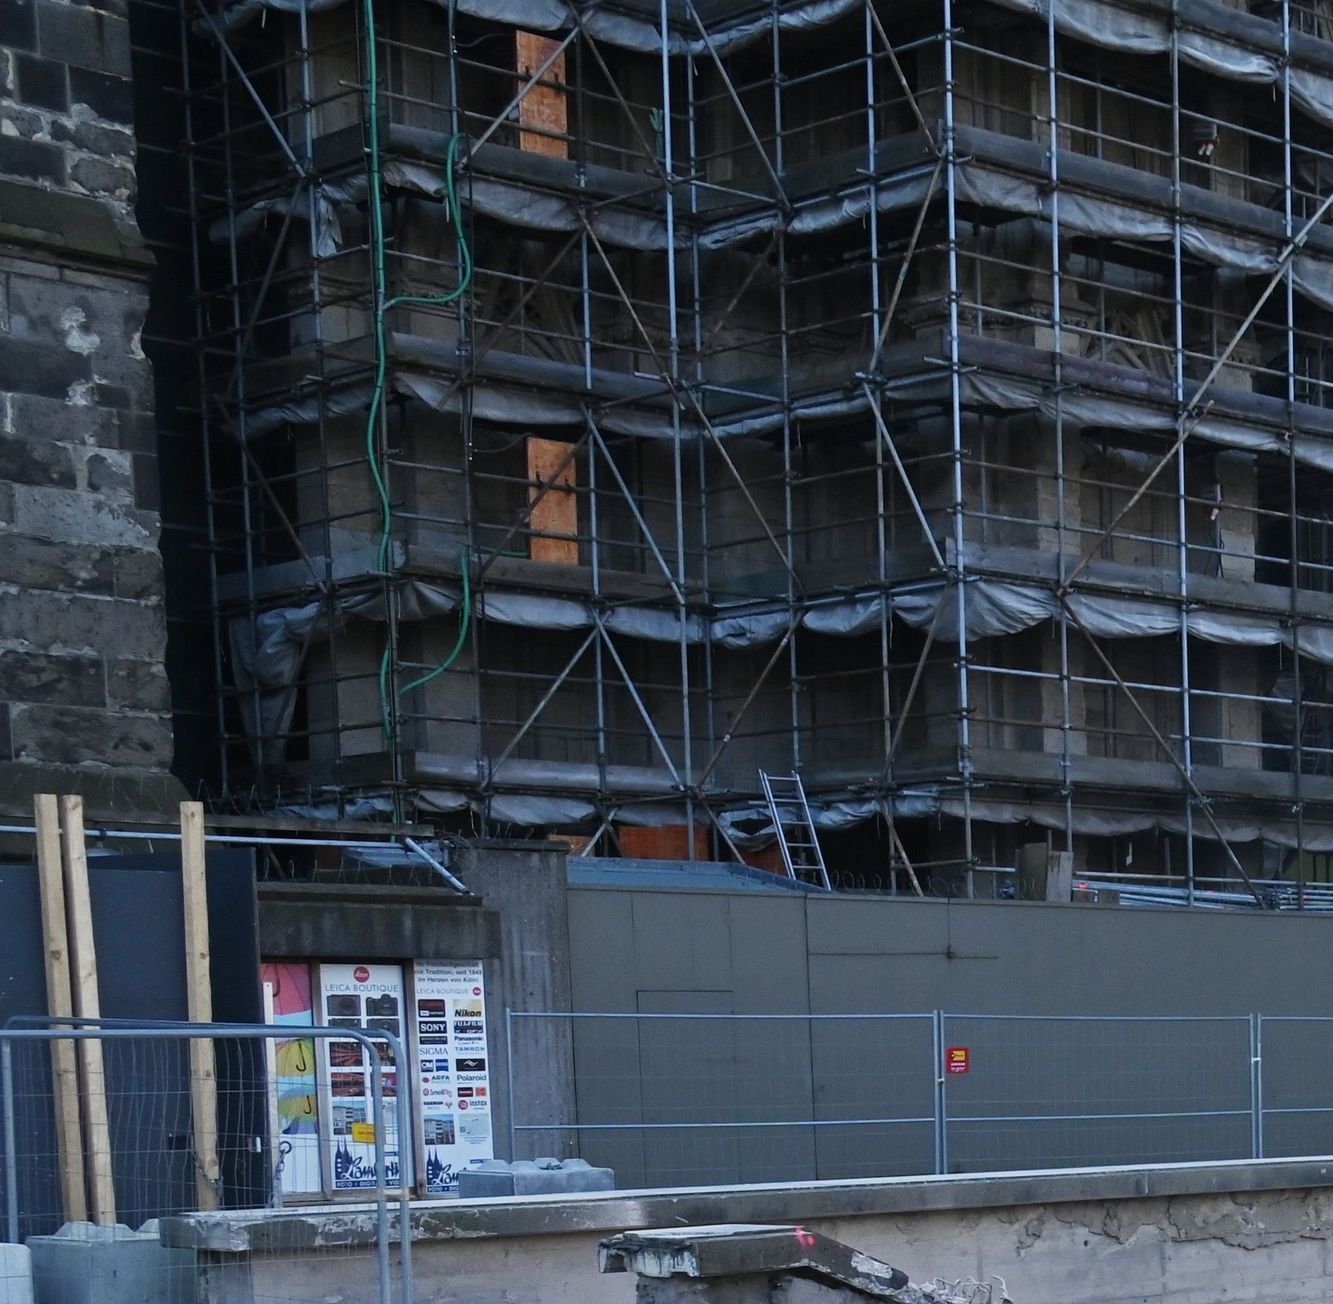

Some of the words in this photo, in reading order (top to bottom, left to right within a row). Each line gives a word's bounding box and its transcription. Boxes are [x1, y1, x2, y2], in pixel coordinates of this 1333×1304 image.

[325, 984, 351, 992] LEICA
[354, 984, 399, 992] BOUTIQUE
[454, 1009, 482, 1017] Nikon
[420, 1024, 446, 1032] SONY
